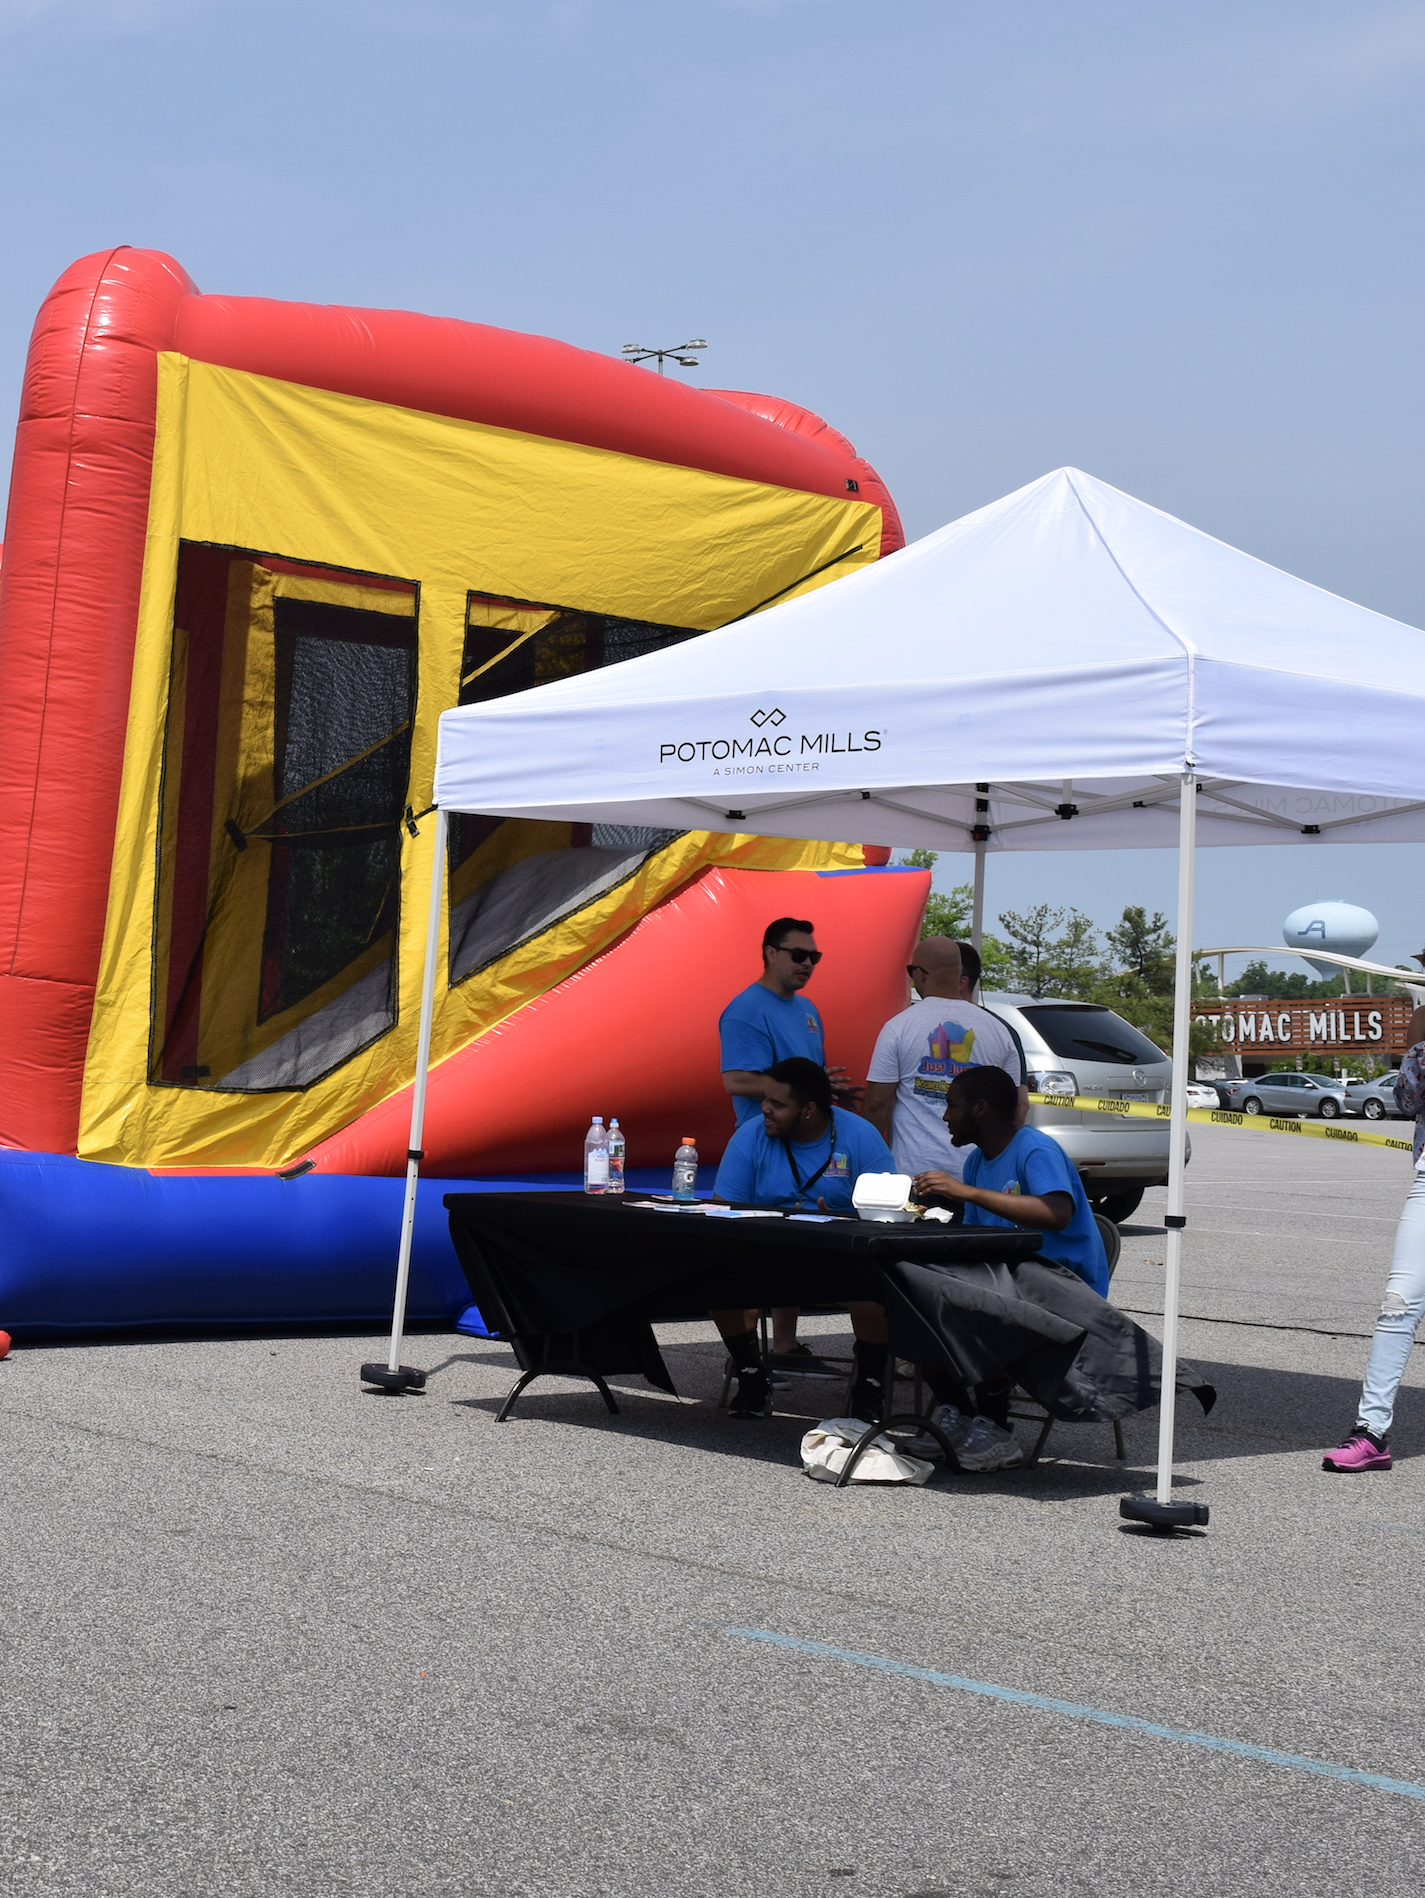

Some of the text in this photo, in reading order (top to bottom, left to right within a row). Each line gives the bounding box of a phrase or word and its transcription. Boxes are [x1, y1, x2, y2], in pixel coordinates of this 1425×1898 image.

[660, 731, 881, 763] POTOMAC MILLS
[713, 762, 820, 776] A SIMON CENTER
[1309, 1011, 1383, 1042] MILLS
[1043, 1094, 1075, 1108] CAUTION
[1097, 1099, 1130, 1113] CUIDADO
[1210, 1111, 1243, 1126] CUIDADO
[1269, 1118, 1302, 1133] CAUTION
[1325, 1127, 1358, 1142] CUIDADO
[1385, 1138, 1413, 1152] CAUTIO
